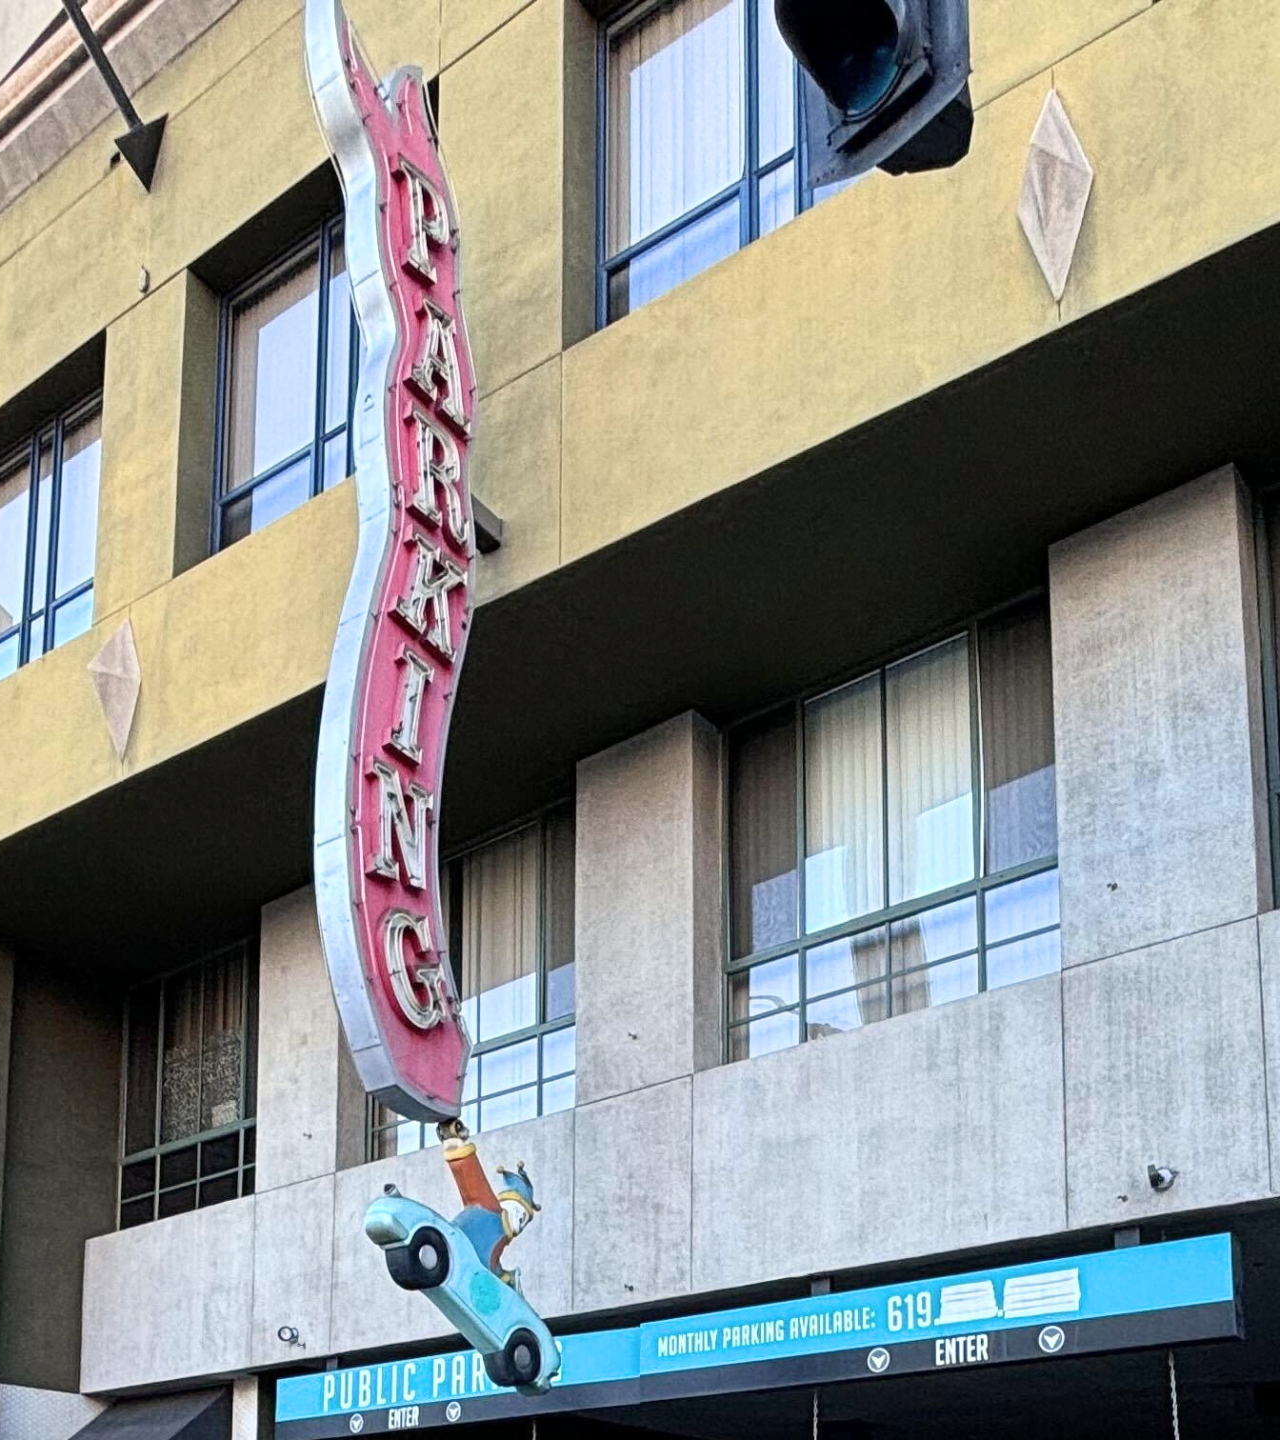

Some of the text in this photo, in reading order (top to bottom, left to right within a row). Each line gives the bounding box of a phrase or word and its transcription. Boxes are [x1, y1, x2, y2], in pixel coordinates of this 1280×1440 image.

[365, 153, 471, 1031] PARKING
[657, 1328, 719, 1357] MONTHLY
[722, 1319, 785, 1349] PARKING
[789, 1306, 876, 1340] AVAILABLE:
[935, 1333, 989, 1367] ENTER
[323, 1362, 417, 1412] PUBLIC
[388, 1405, 420, 1430] ENTER
